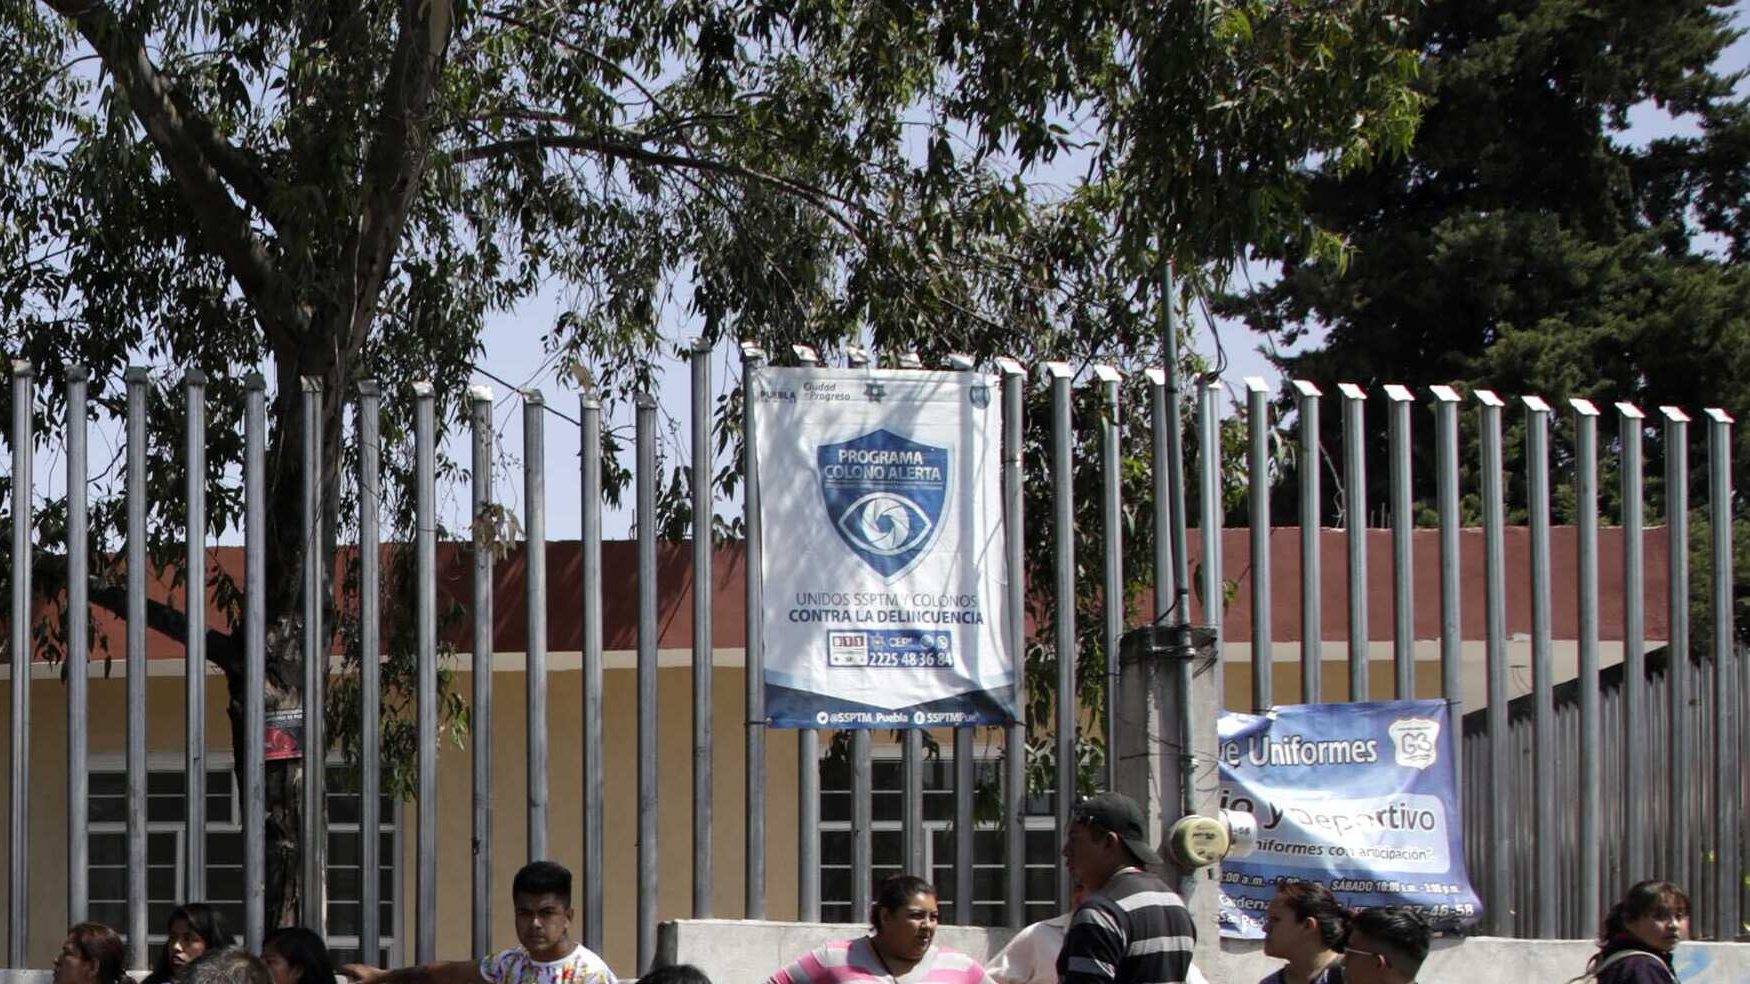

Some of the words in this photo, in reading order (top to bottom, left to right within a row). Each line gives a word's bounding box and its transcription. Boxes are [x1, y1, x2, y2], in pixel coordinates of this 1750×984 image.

[803, 382, 836, 392] Ciudad
[810, 392, 850, 402] Progreso
[838, 450, 923, 465] PROGRAMA
[824, 464, 884, 479] COLONO
[888, 465, 942, 480] ALERTA
[796, 592, 849, 606] UNIDOS
[854, 592, 899, 606] SSPTM
[912, 593, 977, 608] COLONOS
[789, 609, 851, 623] CONTRA
[856, 610, 874, 623] LA
[877, 610, 984, 625] DELINCUENCIA
[869, 652, 899, 666] 2225
[901, 652, 917, 666] 48
[919, 652, 934, 666] 36
[937, 652, 953, 667] 84
[1249, 735, 1378, 768] Uniformes
[1264, 802, 1284, 830] y
[1331, 878, 1372, 892] SÁBADO
